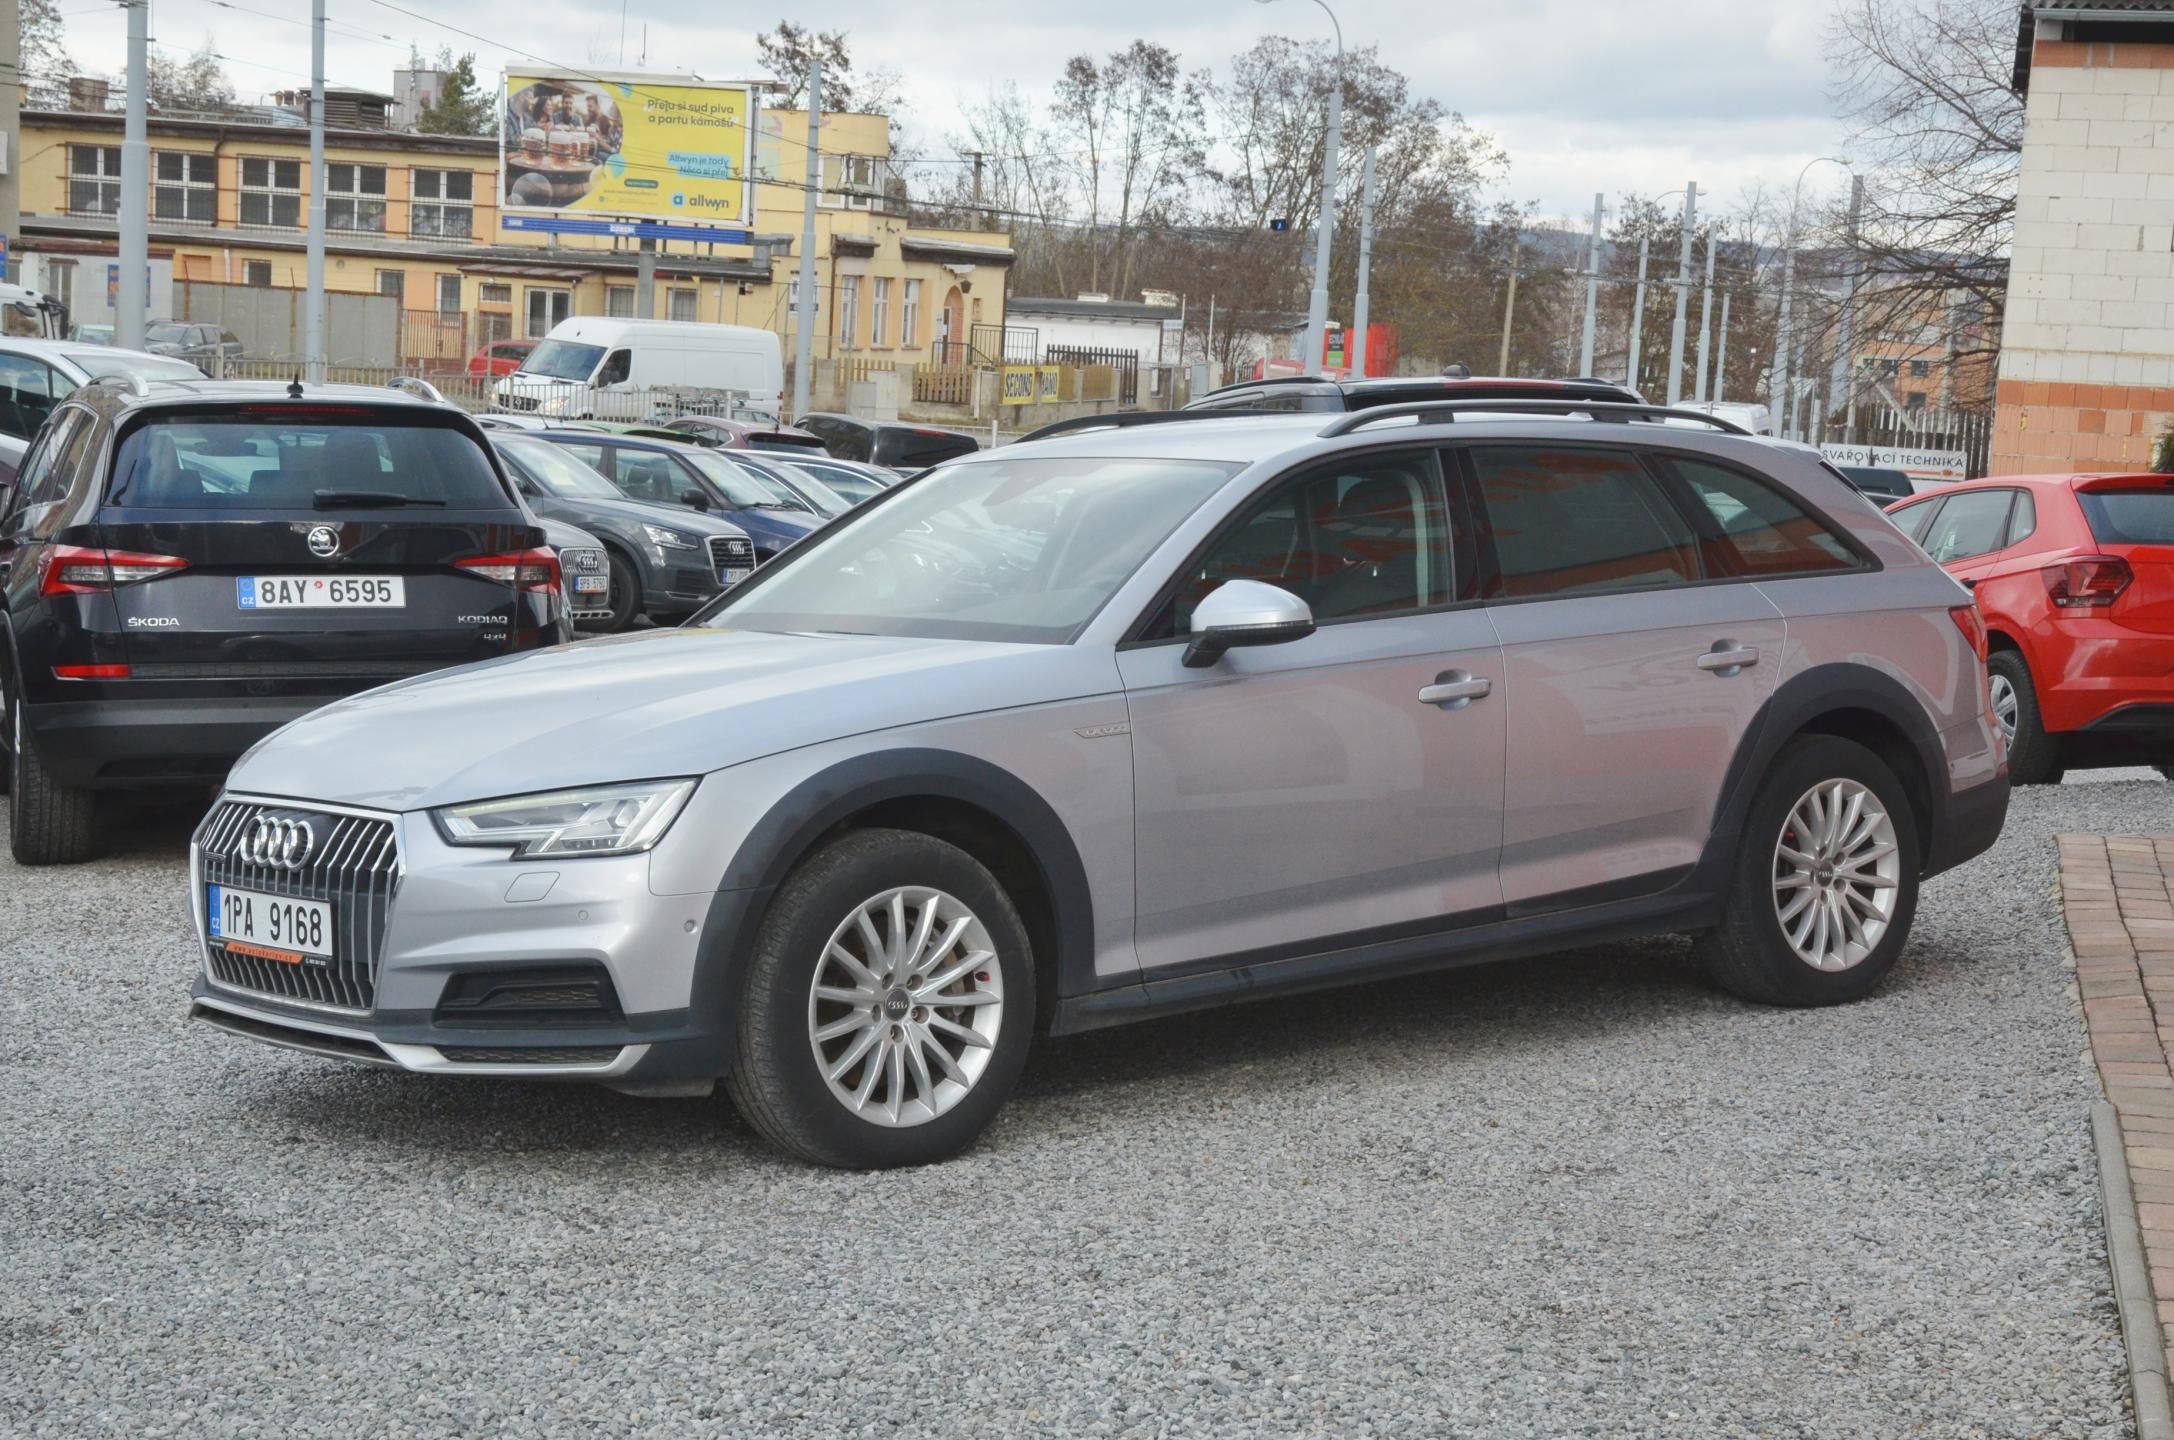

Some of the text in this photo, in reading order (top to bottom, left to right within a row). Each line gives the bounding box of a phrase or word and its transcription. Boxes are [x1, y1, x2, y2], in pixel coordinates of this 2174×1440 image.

[678, 101, 687, 110] si
[689, 101, 708, 112] sud
[710, 103, 734, 115] piva
[648, 115, 656, 123] a
[658, 115, 688, 125] partu
[689, 194, 730, 211] allwyn
[1004, 372, 1033, 398] SECOND
[1900, 455, 1964, 468] TECHNIKA
[261, 580, 307, 603] 8AY
[330, 579, 392, 603] 6595
[127, 616, 180, 627] ŠKODA
[457, 615, 508, 625] KODIAQ
[211, 894, 322, 948] CZ 1PA 9168
